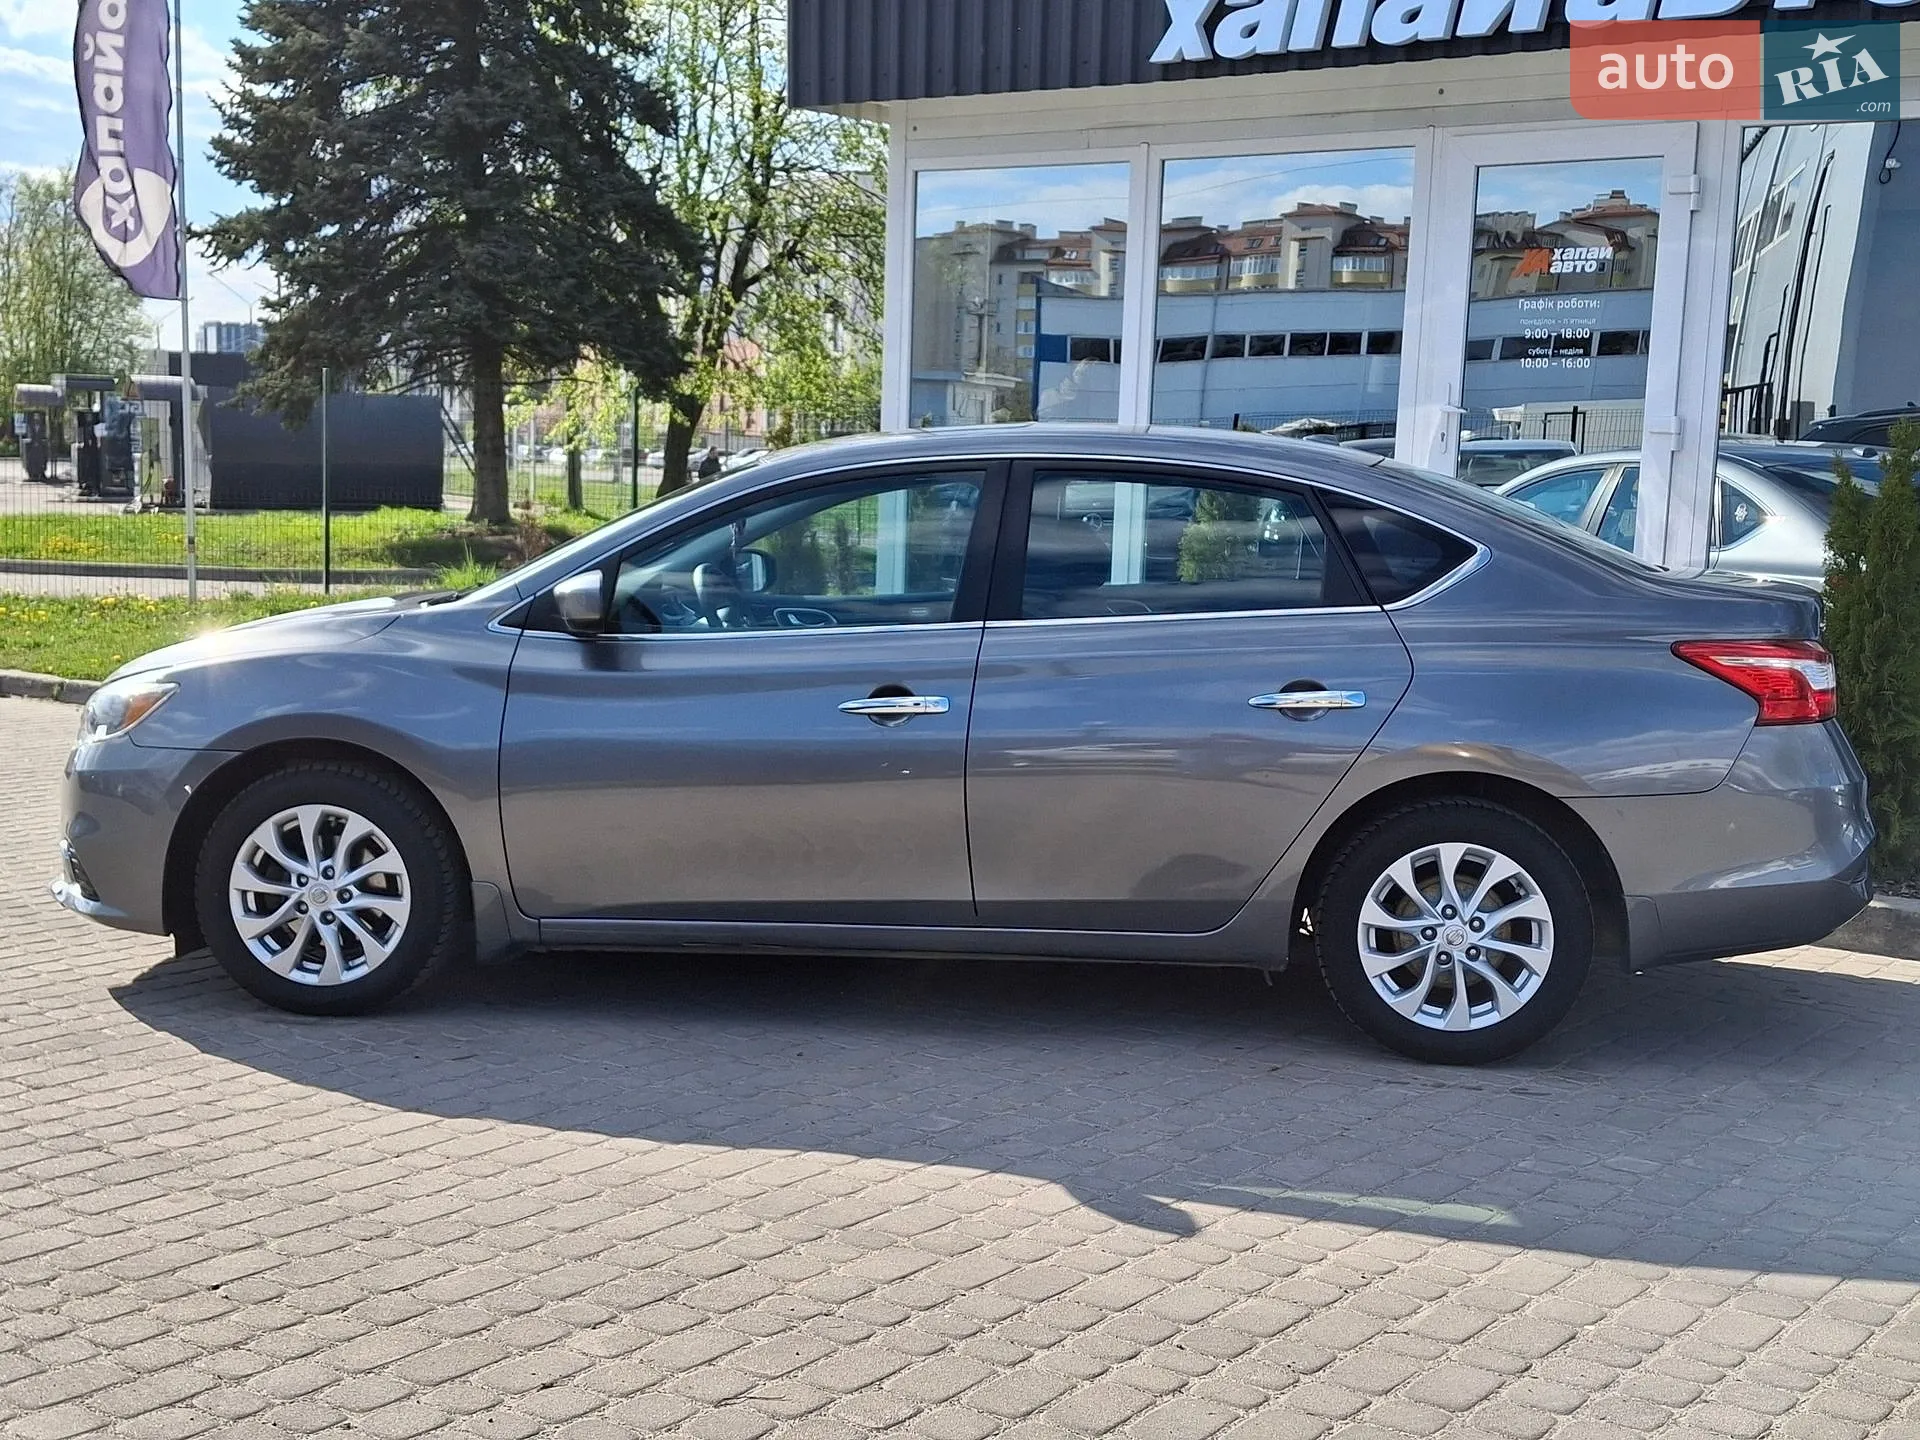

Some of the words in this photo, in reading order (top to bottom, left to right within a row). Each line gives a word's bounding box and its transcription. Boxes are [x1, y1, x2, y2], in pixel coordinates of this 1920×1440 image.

[1549, 260, 1598, 274] авто
[1518, 298, 1554, 311] Графік
[1557, 297, 1601, 310] роботи:
[1524, 328, 1549, 339] 9:00
[1560, 328, 1590, 339] 18:00
[1559, 346, 1584, 356] неділя
[1520, 358, 1549, 368] 10:00
[1561, 357, 1591, 368] 16:00
